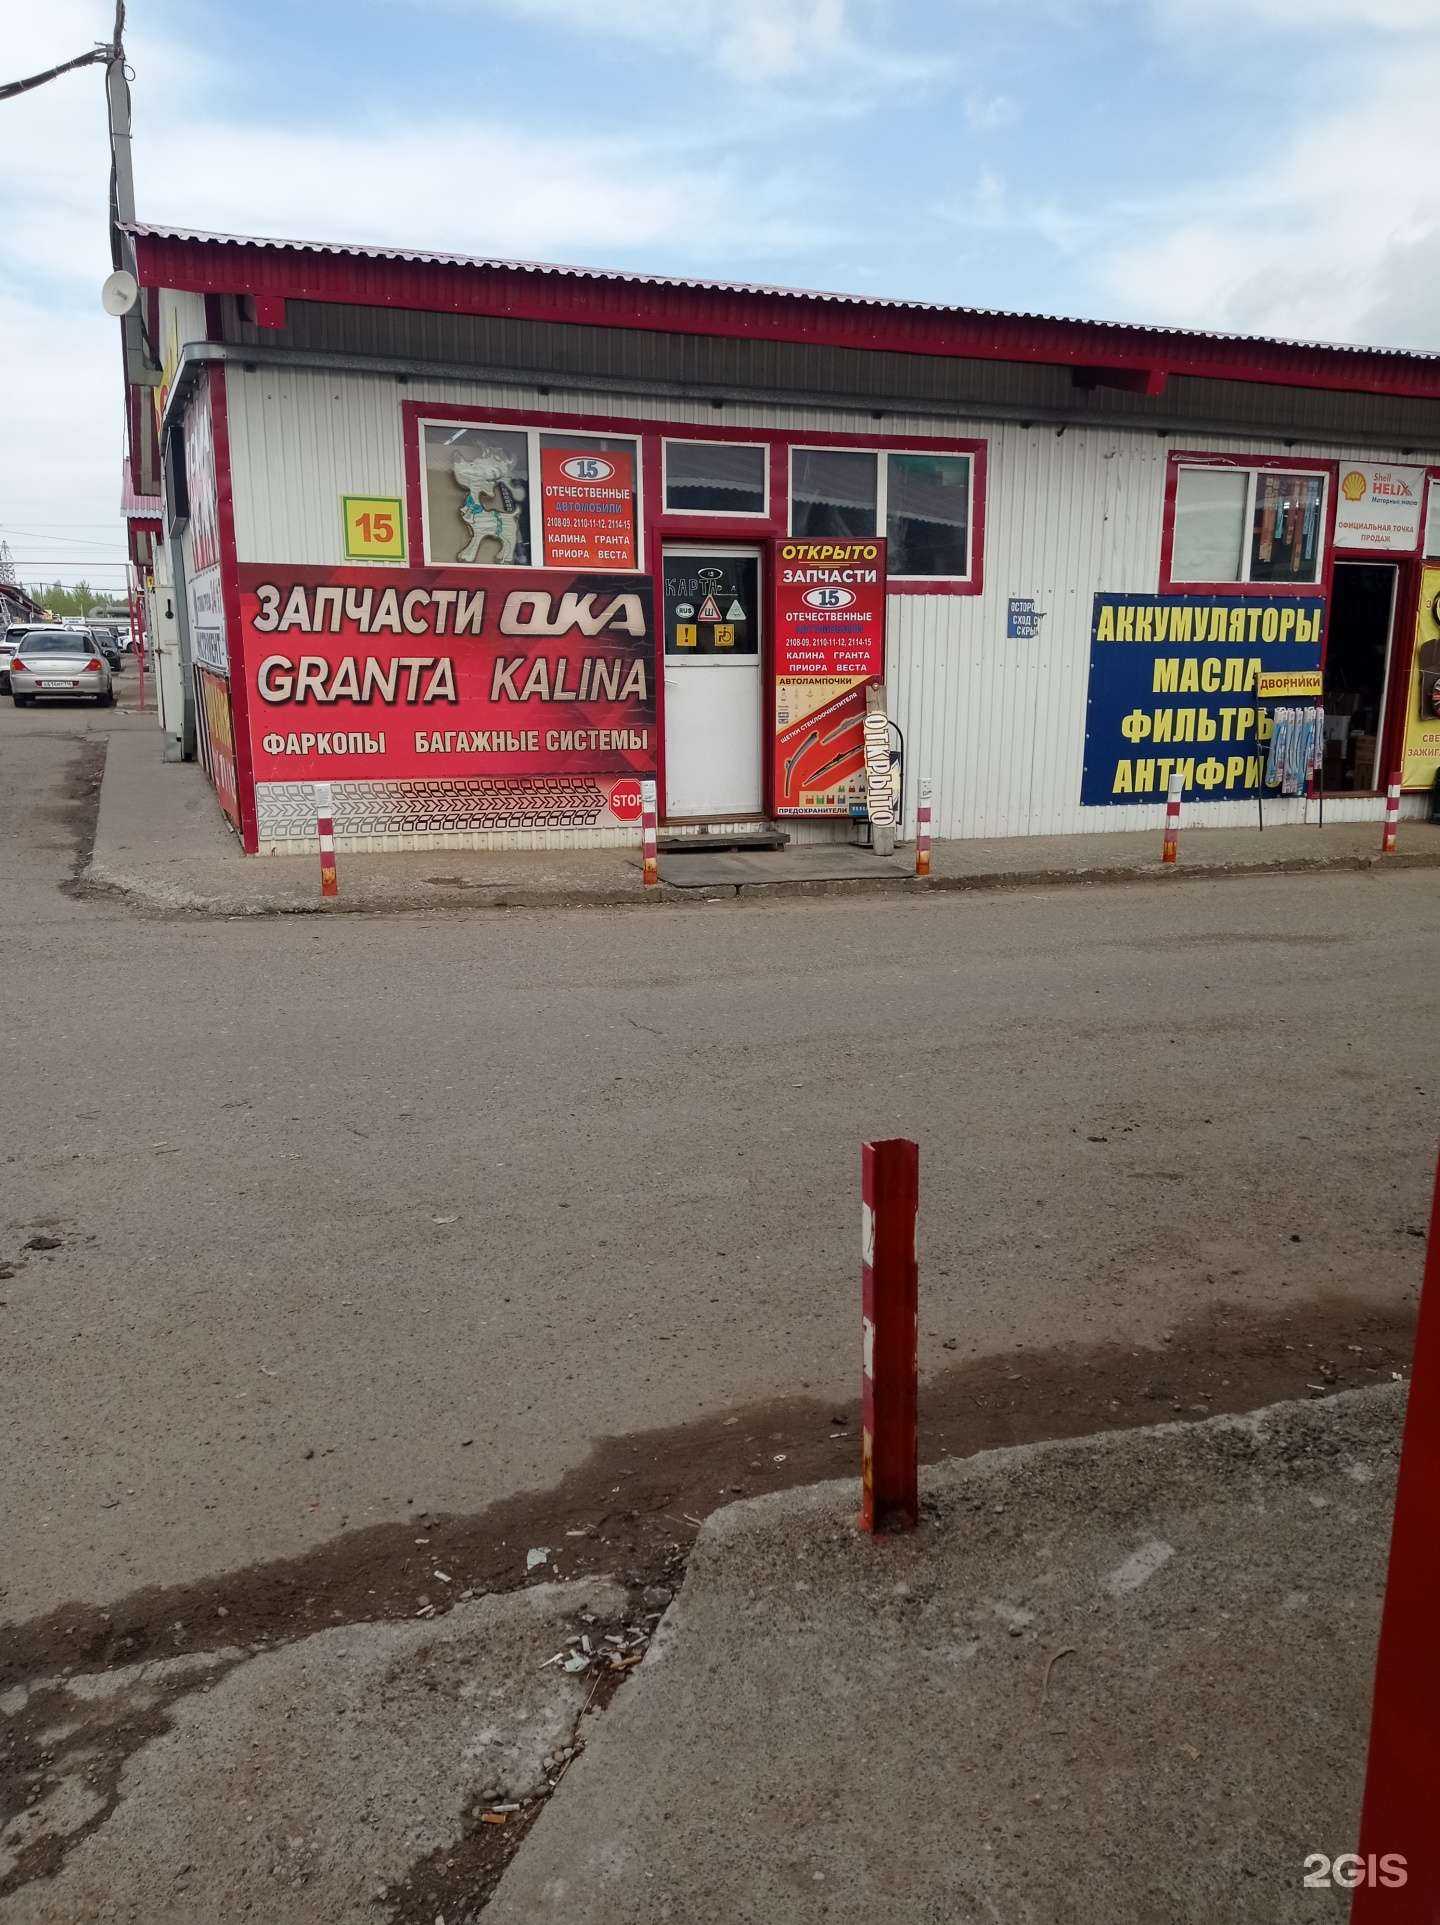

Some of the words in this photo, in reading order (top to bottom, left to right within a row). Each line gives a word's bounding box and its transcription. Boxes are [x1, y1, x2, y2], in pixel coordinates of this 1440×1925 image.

[577, 461, 599, 479] 15
[1373, 472, 1391, 483] Shell
[546, 486, 630, 499] ОТЕЧЕСТВЕННЫЕ
[1373, 482, 1412, 496] HELIX
[555, 502, 622, 513] АВТОМОБИЛИ
[355, 513, 394, 543] 15
[1339, 522, 1392, 531] ОФИЦИАЛЬНАЯ
[1393, 525, 1414, 533] ТОЧКА
[548, 534, 586, 544] КАЛИНА
[594, 535, 630, 545] ГРАНТА
[1361, 534, 1391, 542] ПРОДАЖ
[552, 549, 590, 559] ПРИОРА
[598, 550, 628, 560] ВЕСТА
[782, 545, 878, 560] ОТКРЫТО
[783, 569, 877, 583] ЗАПЧАСТИ
[665, 578, 718, 597] КАРТА
[818, 590, 840, 606] 15
[253, 584, 485, 635] ЗАПЧАСТИ
[785, 612, 872, 621] ОТЕЧЕСТВЕННЫЕ
[1012, 615, 1031, 625] СХОД
[1097, 606, 1321, 642] АККУМУЛЯТОРЫ
[848, 638, 872, 646] 2114-15
[786, 651, 825, 660] КАЛИНА
[833, 651, 870, 660] ГРАНТА
[789, 664, 828, 672] ПРИОРА
[836, 664, 867, 672] ВЕСТА
[257, 654, 457, 701] GRANTA
[489, 657, 648, 702] KALINA
[779, 677, 852, 685] АВТОЛАМПОЧКИ
[1152, 657, 1262, 693] МАСЛА
[1260, 677, 1321, 690] ДВОРНИКИ
[780, 728, 801, 744] ЩЕТКИ
[801, 692, 858, 731] СТЕКЛООЧИСТИТЕЛЯ
[262, 732, 386, 755] ФАРКОПЫ
[414, 731, 540, 754] БАГАЖНЫЕ
[545, 729, 649, 752] СИСТЕМЫ
[1408, 749, 1440, 757] ЗАЖИГ
[864, 713, 895, 827] ОТКРЫТО
[1112, 756, 1282, 794] АНТИФРИ
[778, 807, 848, 815] ПРЕДОХРАНИТЕЛИ
